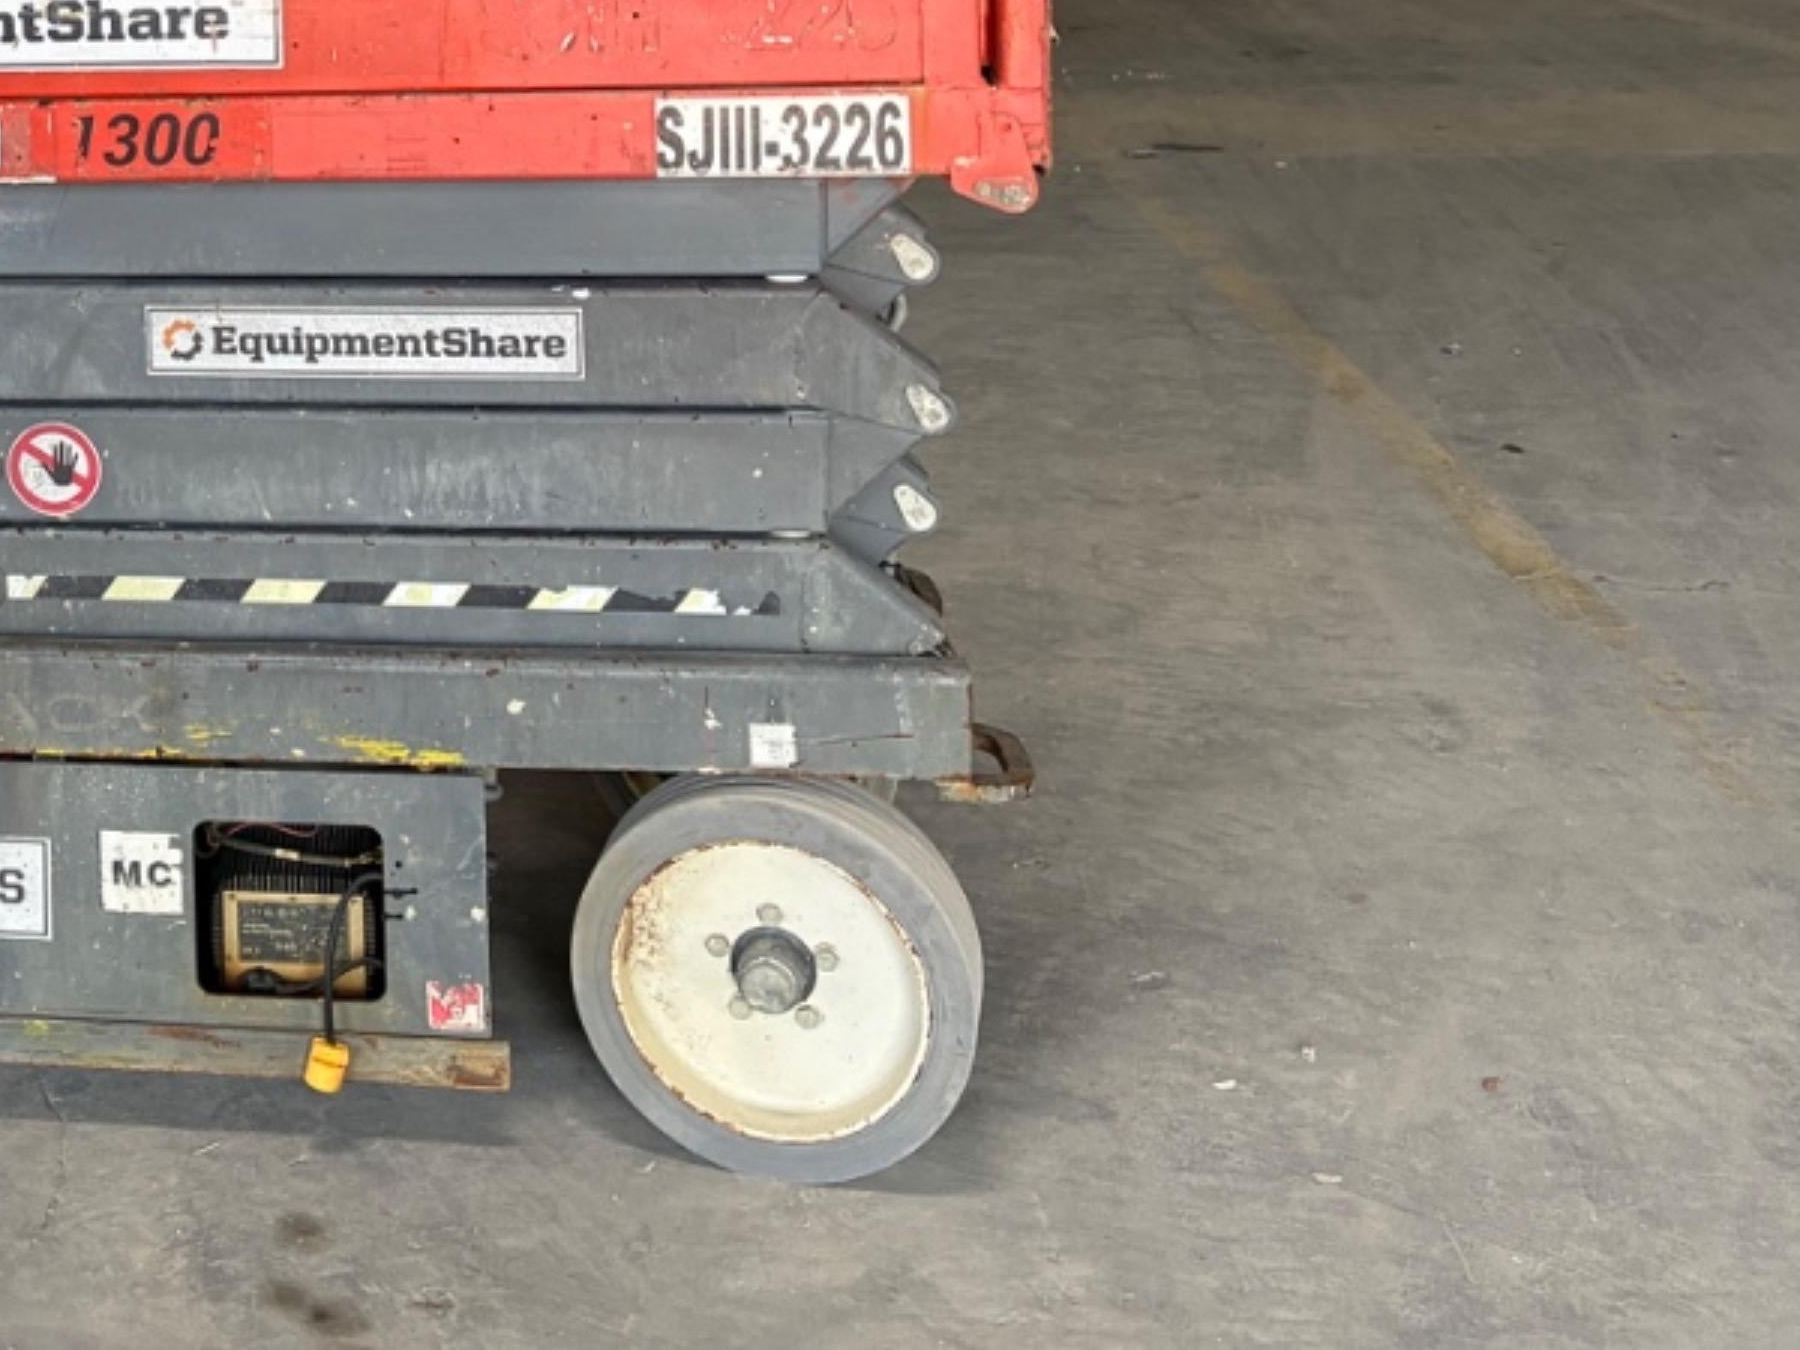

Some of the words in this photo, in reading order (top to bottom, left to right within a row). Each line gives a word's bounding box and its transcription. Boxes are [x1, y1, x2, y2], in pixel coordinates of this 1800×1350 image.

[78, 112, 220, 166] 1300
[657, 101, 904, 172] SJIII-3226
[211, 325, 568, 360] EquipmentShare
[112, 860, 172, 888] MC
